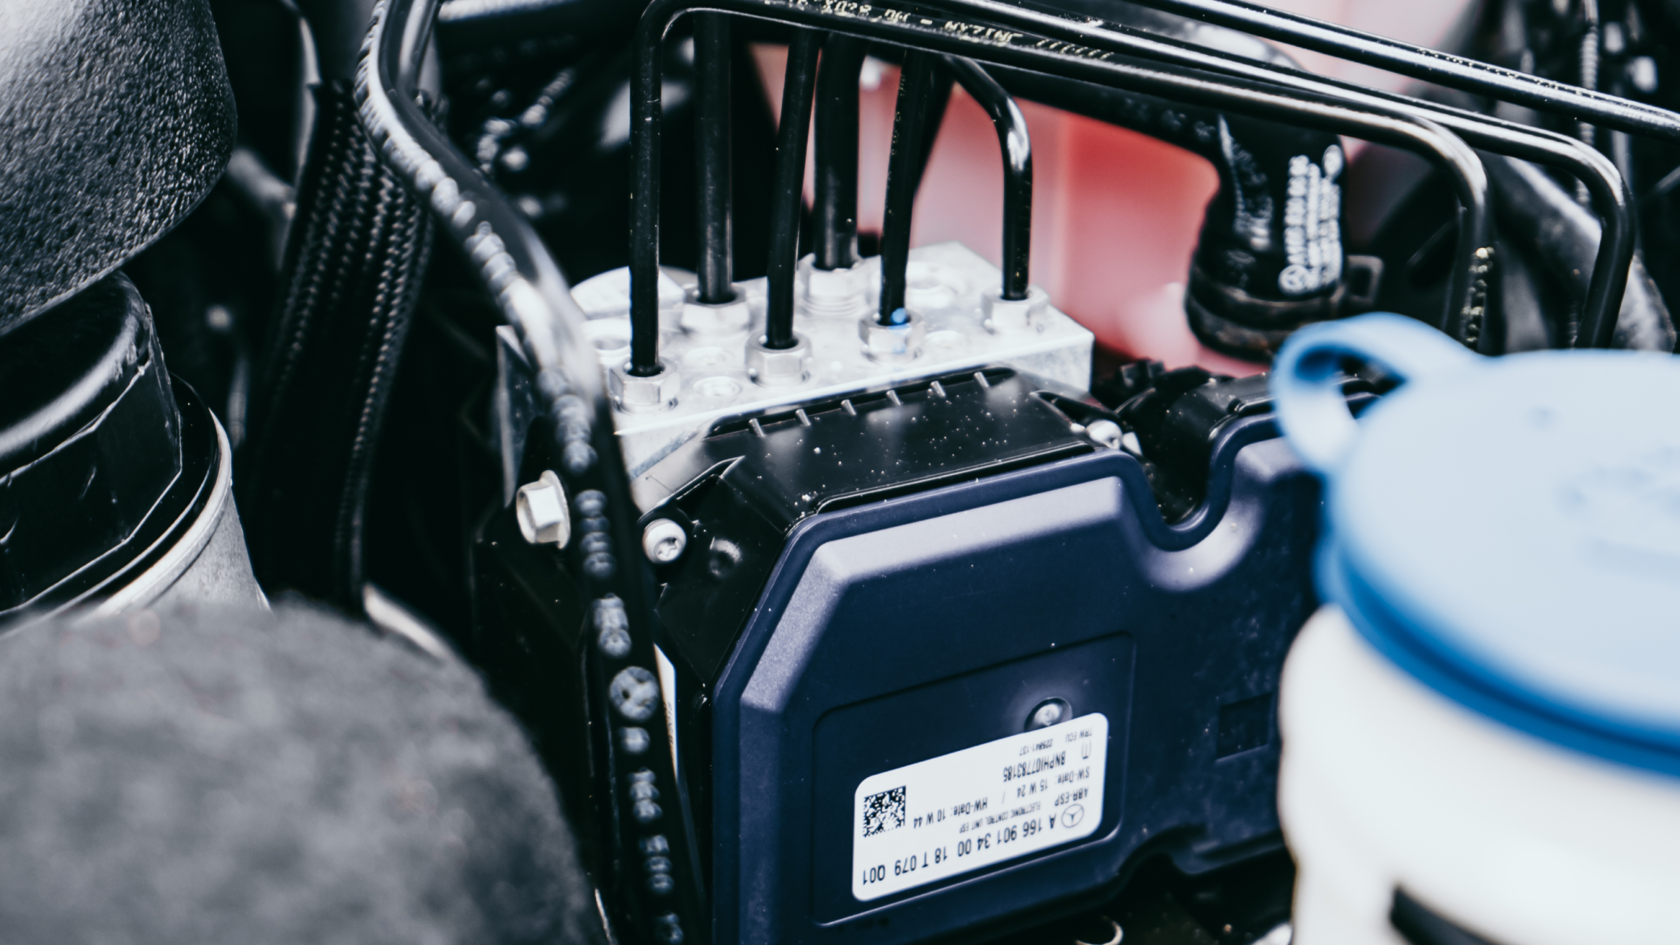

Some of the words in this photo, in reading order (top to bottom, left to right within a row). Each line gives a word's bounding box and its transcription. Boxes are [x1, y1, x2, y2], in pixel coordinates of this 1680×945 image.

[1017, 786, 1027, 798] 24
[1029, 782, 1037, 795] W
[1039, 779, 1049, 792] 15
[937, 808, 946, 822] 10
[951, 797, 988, 816] HW-Date:
[914, 816, 924, 829] 44
[925, 811, 935, 825] W
[1049, 814, 1056, 829] A
[997, 825, 1017, 845] 901
[1023, 818, 1042, 837] 166
[958, 839, 972, 857] 00
[977, 833, 991, 851] 34
[921, 852, 930, 868] T
[934, 846, 948, 864] 18
[894, 856, 917, 876] 079
[863, 865, 885, 885] Q01
